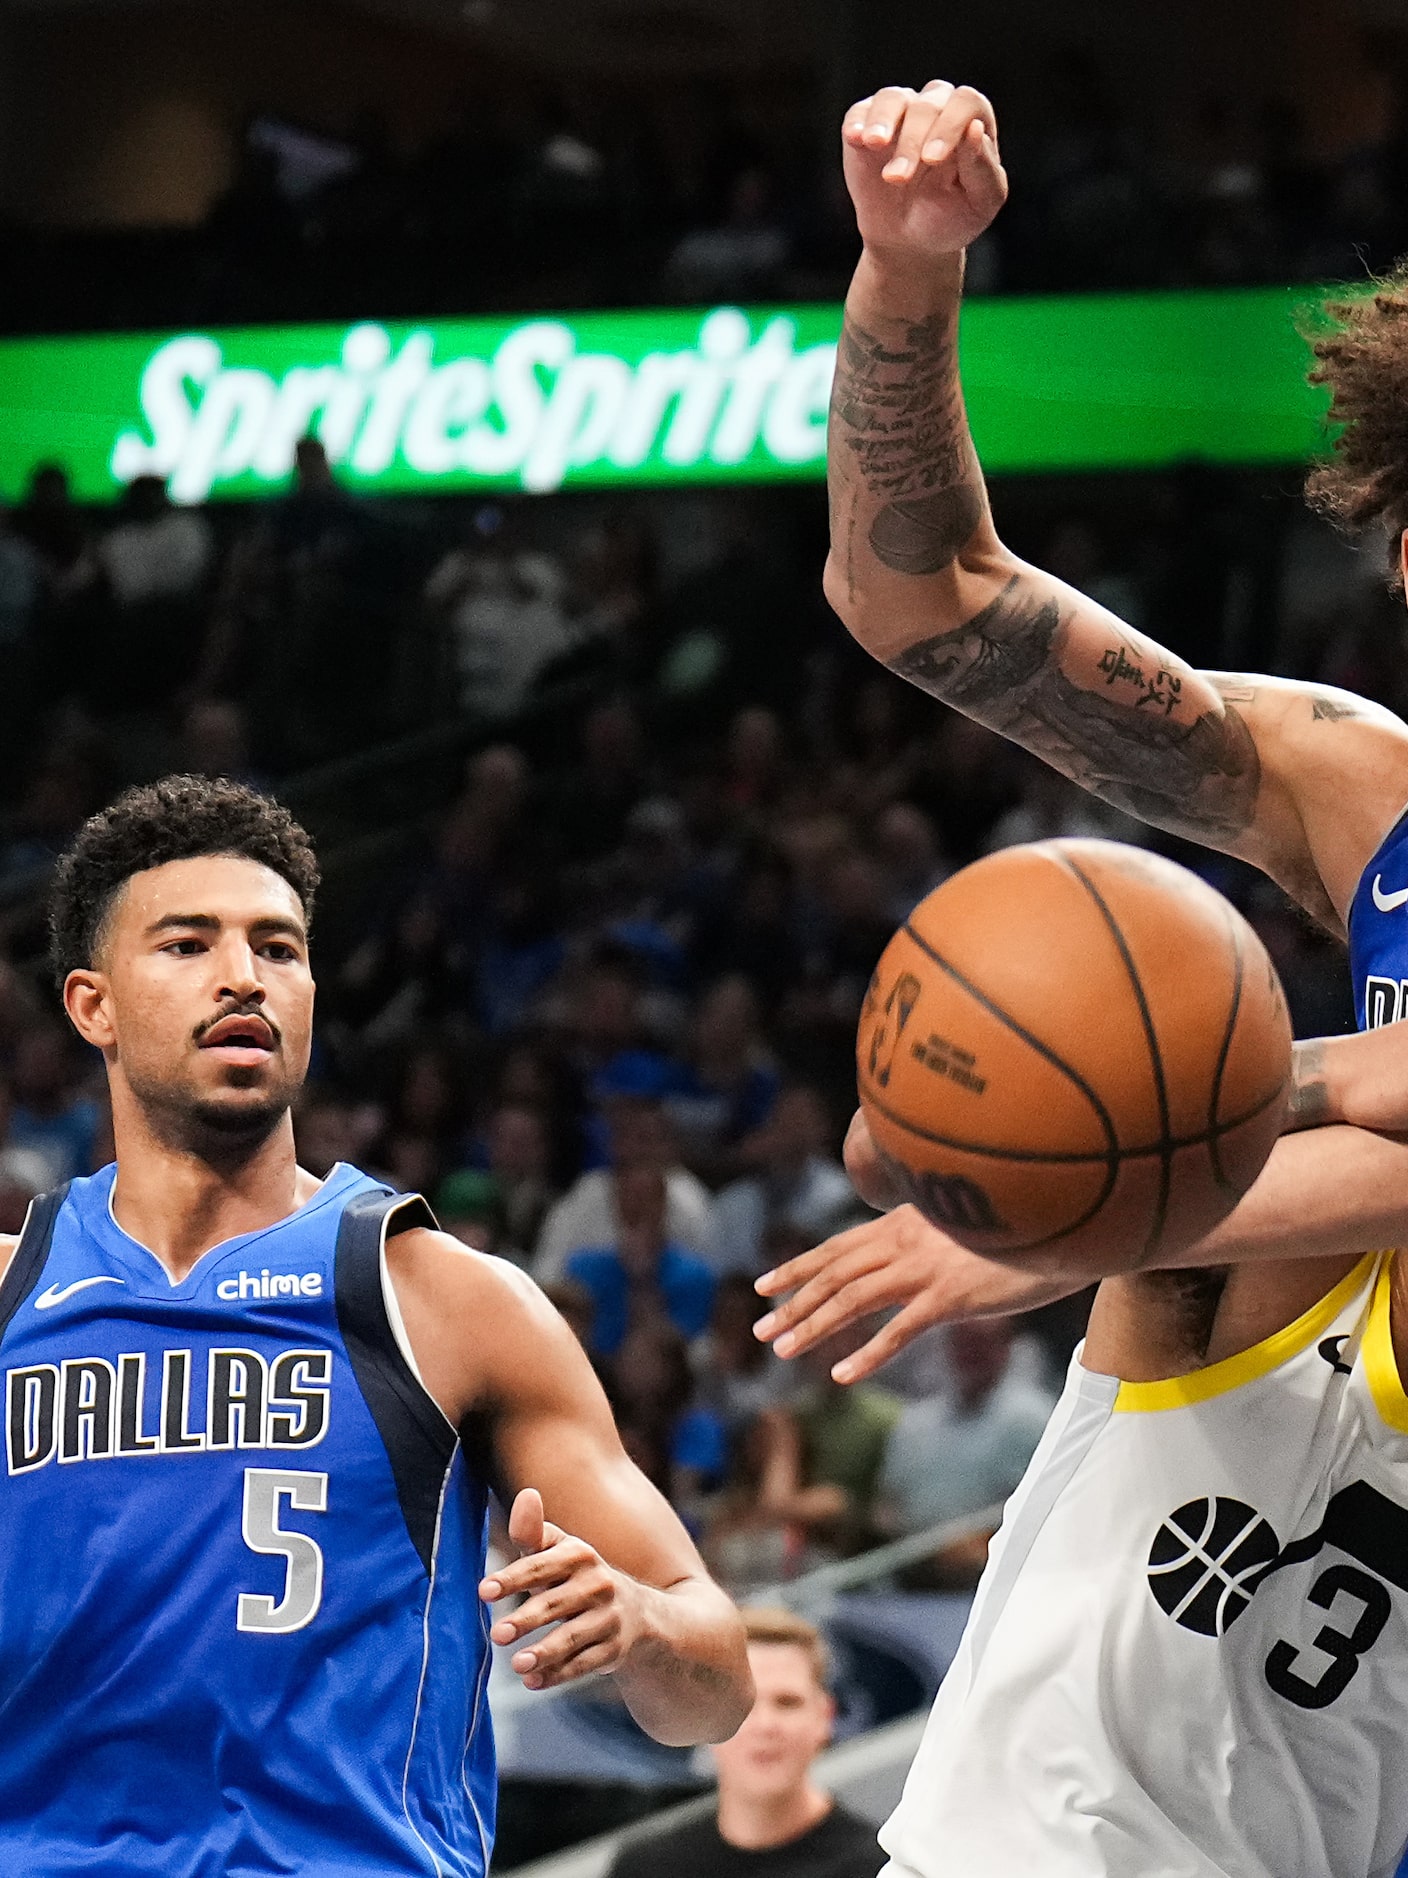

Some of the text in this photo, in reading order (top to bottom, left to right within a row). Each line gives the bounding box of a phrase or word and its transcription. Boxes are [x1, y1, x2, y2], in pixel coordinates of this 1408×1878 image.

[216, 1270, 323, 1301] chime
[6, 1348, 332, 1476] DALLAS
[237, 1468, 329, 1634] 5
[1265, 1564, 1392, 1710] 3
